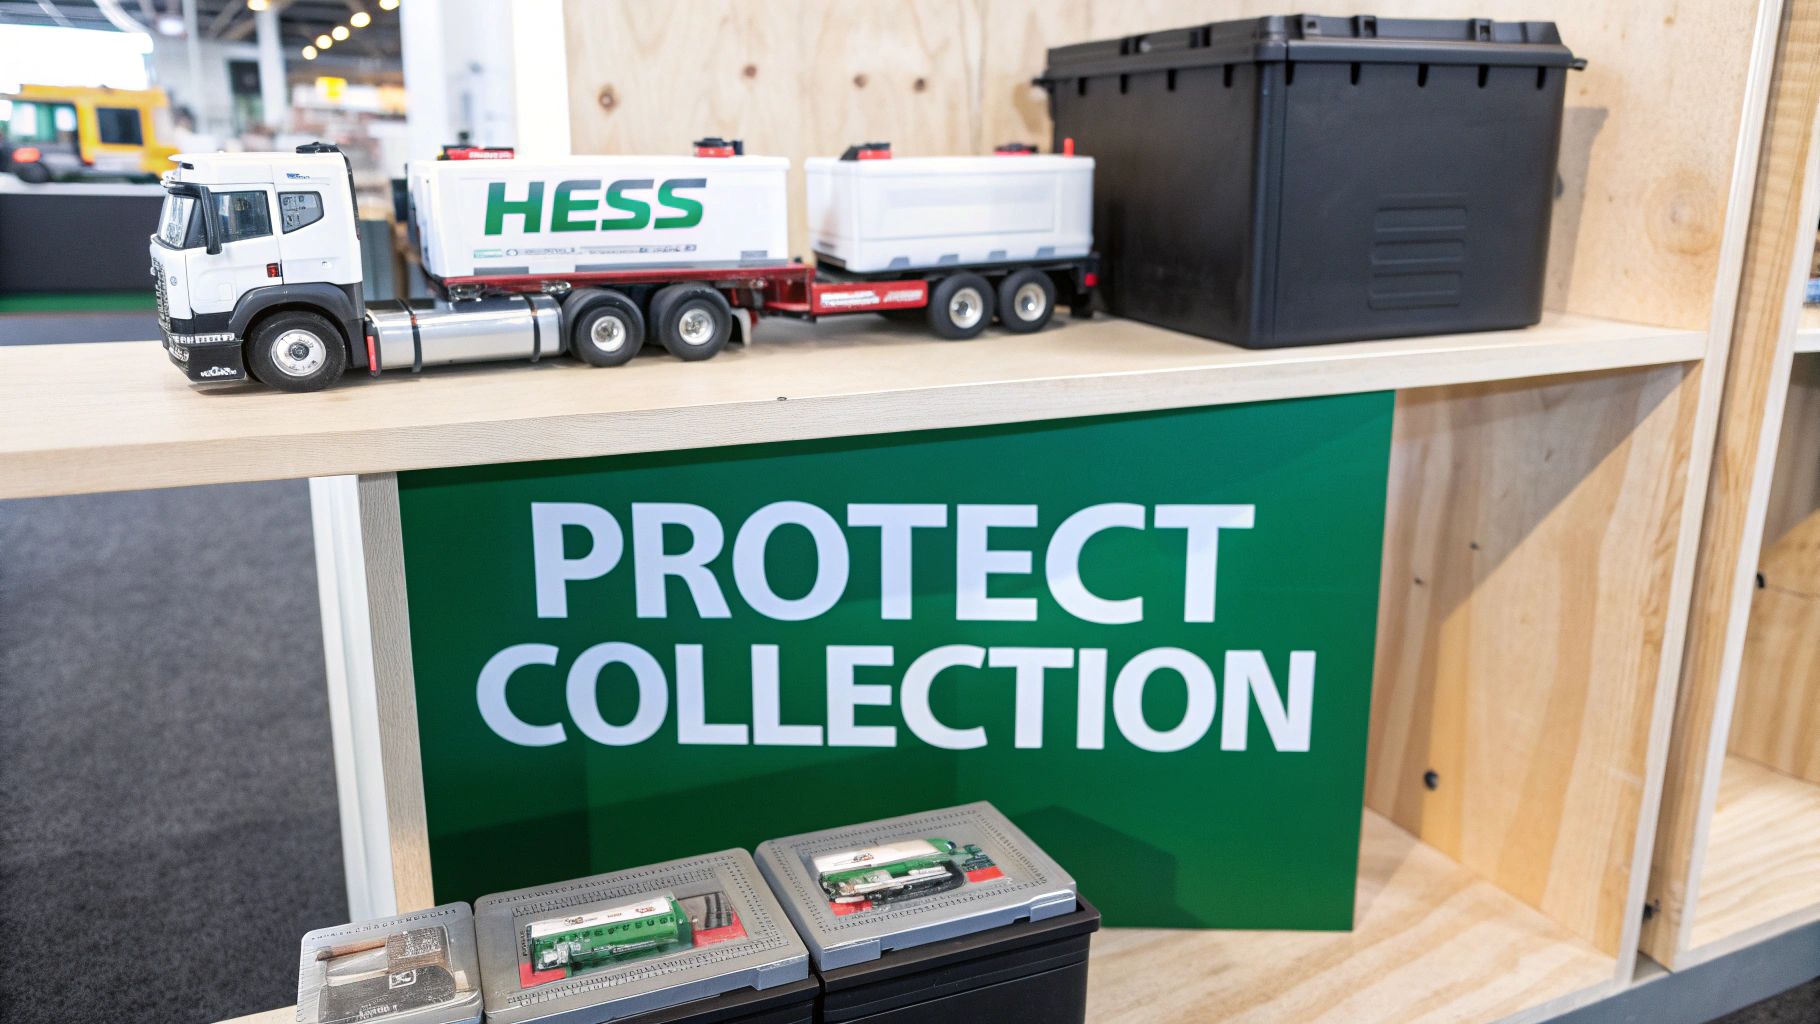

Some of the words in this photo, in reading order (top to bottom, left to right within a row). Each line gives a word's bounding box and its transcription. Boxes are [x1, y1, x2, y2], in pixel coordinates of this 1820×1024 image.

[484, 178, 707, 236] HESS
[530, 501, 1256, 624] PROTECT
[476, 642, 1316, 752] COLLECTION
